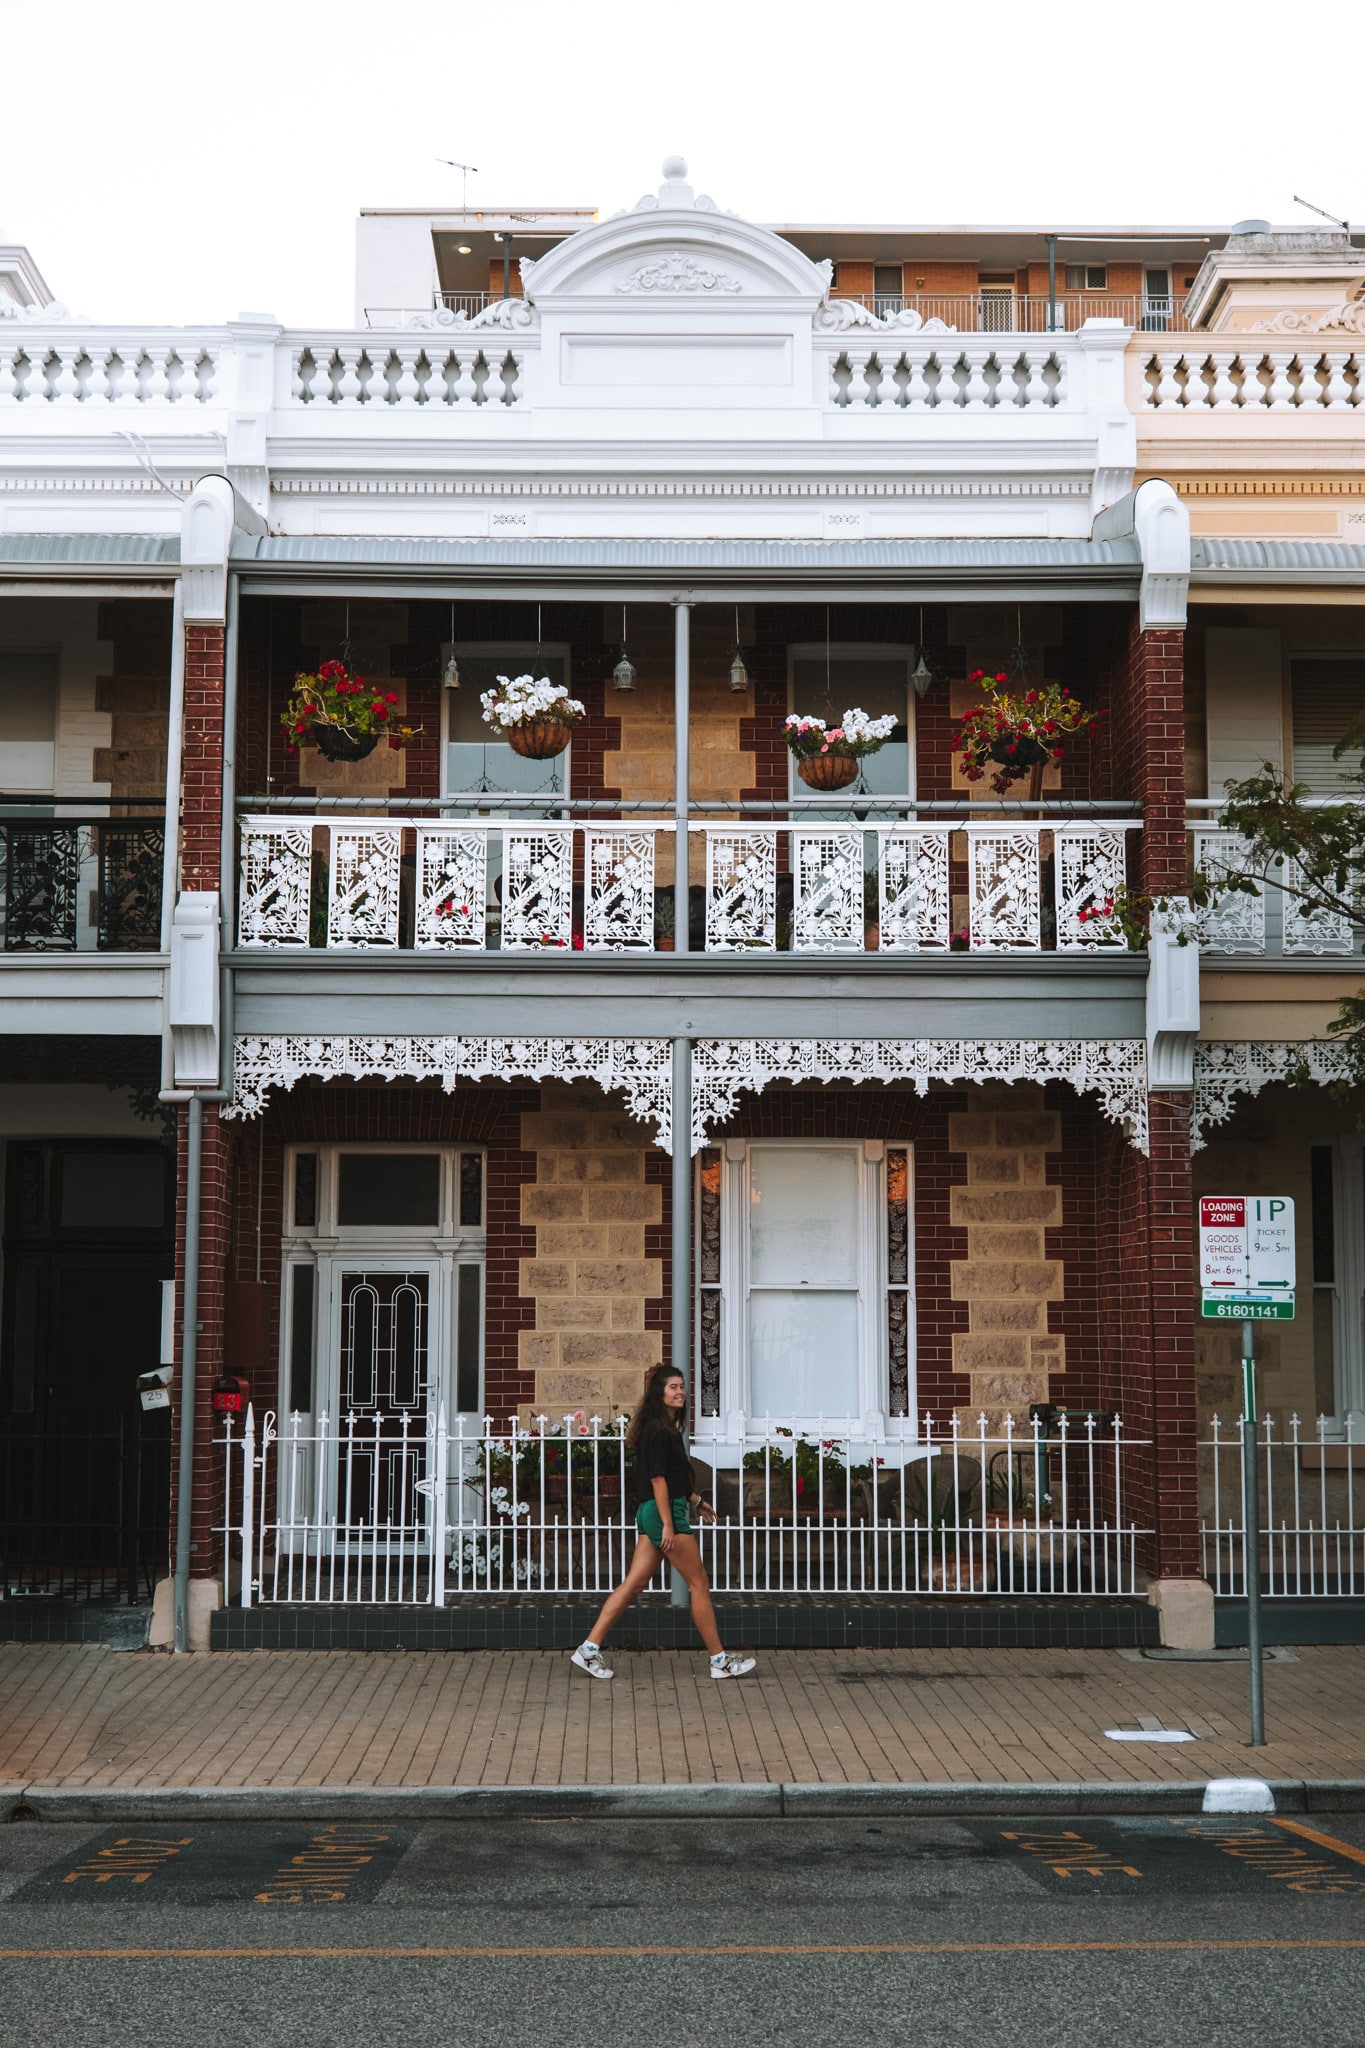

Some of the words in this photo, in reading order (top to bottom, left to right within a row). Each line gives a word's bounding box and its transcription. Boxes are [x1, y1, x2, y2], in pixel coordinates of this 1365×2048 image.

[1202, 1202, 1243, 1212] LOADING
[1210, 1213, 1236, 1222] ZONE
[1207, 1234, 1239, 1243] GOODS
[1204, 1245, 1242, 1253] VEHICLES
[1217, 1305, 1278, 1317] 61601141
[147, 1391, 162, 1401] 25
[218, 1394, 236, 1408] 23
[999, 1830, 1144, 1878] ZONE
[62, 1837, 195, 1884] ZONE
[254, 1824, 398, 1904] LOADING
